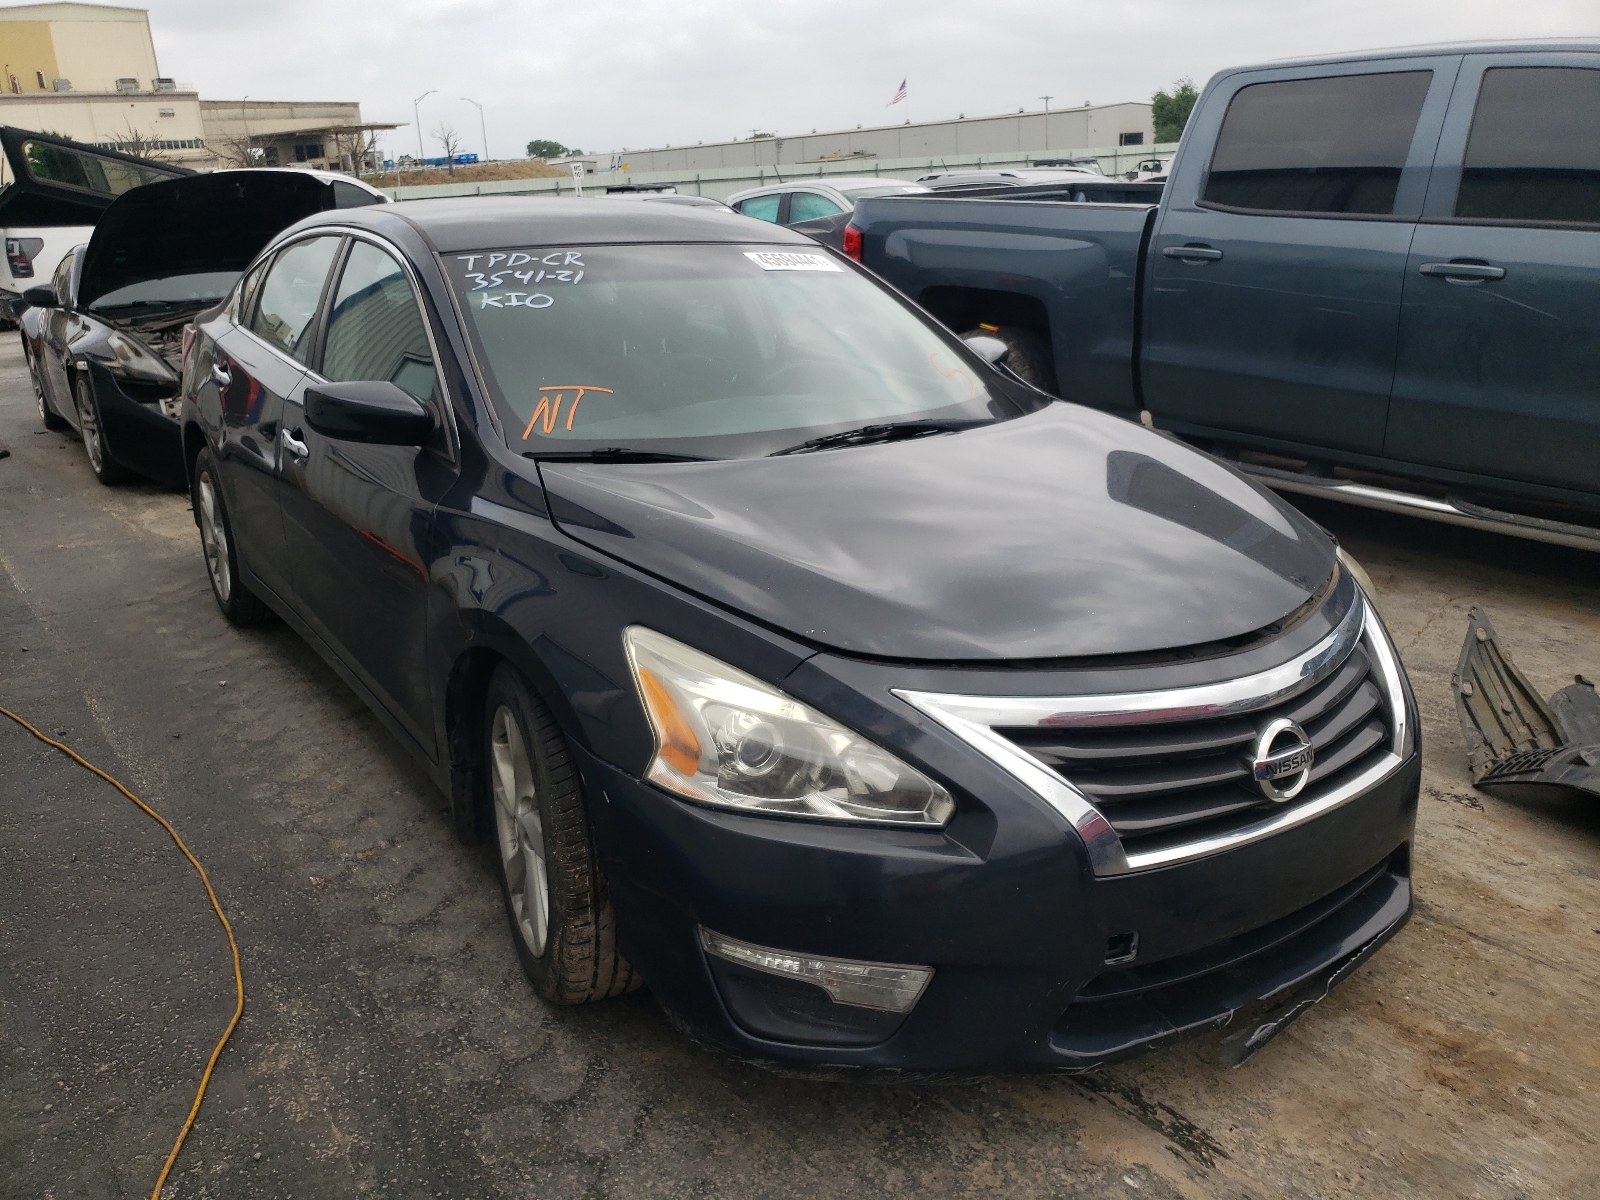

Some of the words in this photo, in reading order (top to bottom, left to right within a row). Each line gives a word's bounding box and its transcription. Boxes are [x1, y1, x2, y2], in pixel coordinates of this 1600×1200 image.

[465, 270, 585, 291] 3541-21
[522, 385, 613, 440] NT
[1266, 750, 1313, 775] NISSAN
